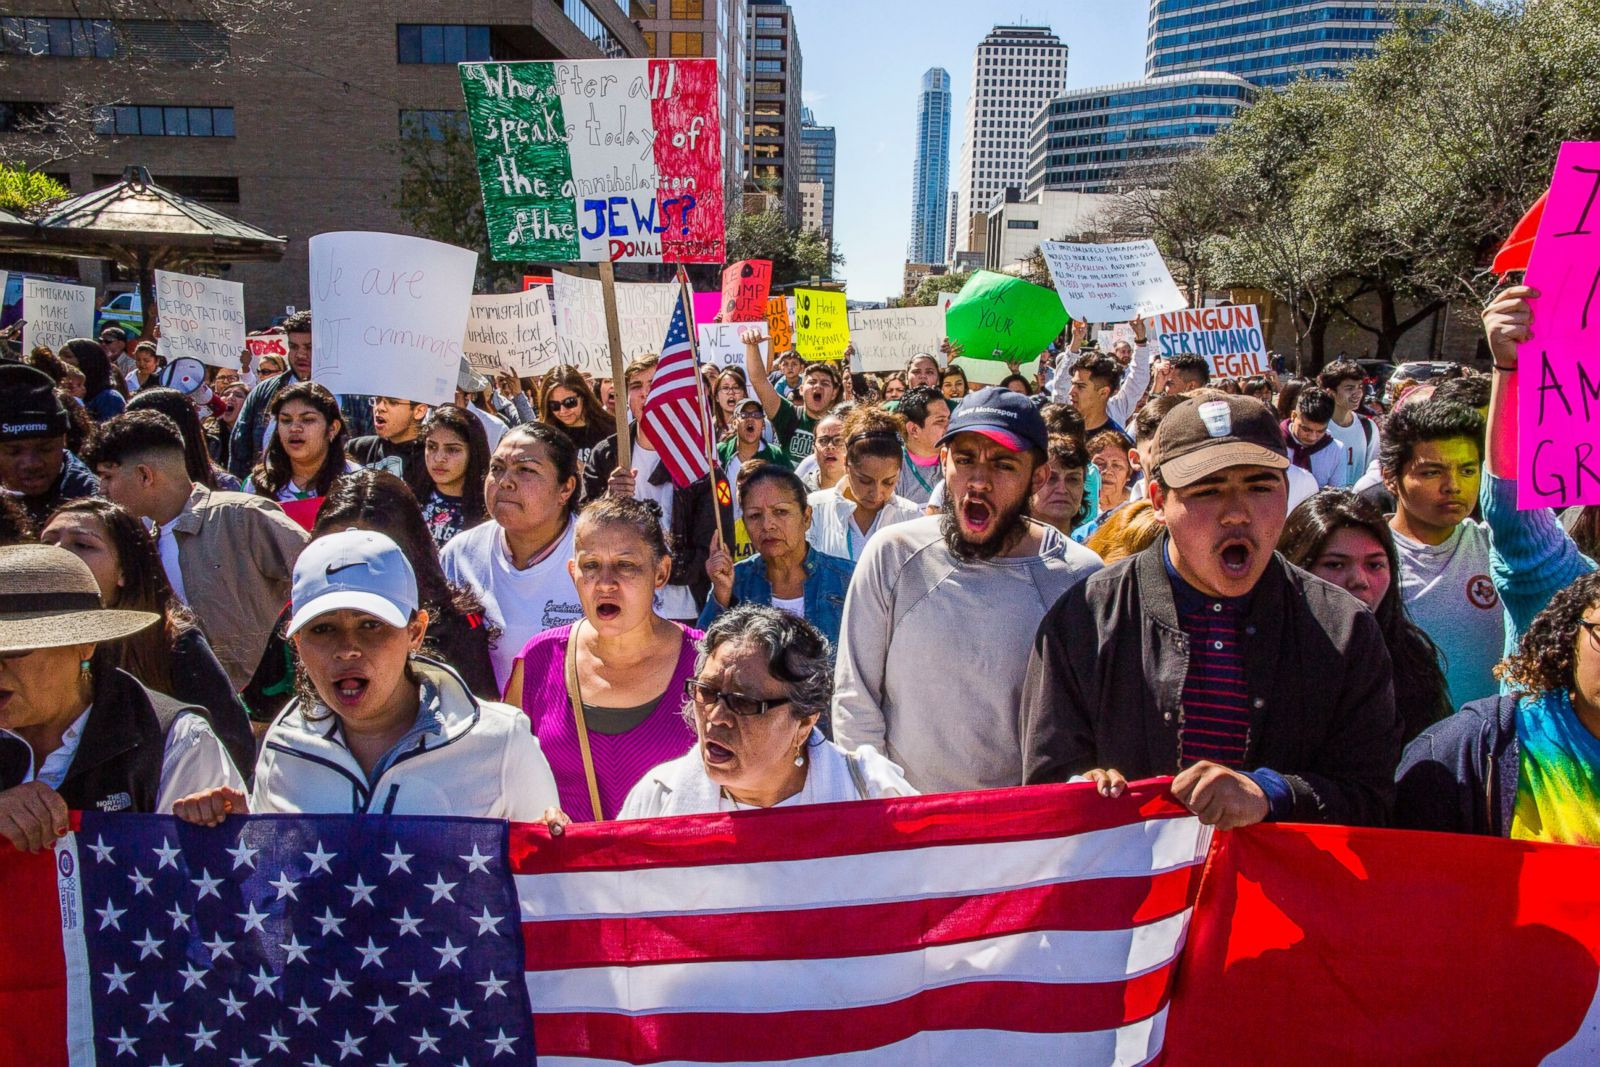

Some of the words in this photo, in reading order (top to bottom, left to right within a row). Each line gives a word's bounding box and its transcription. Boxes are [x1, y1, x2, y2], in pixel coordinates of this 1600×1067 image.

[547, 64, 617, 98] after
[485, 108, 576, 153] speaks
[585, 102, 657, 161] today
[671, 116, 705, 151] of
[495, 154, 548, 196] the
[560, 163, 697, 197] annihilation
[608, 239, 669, 260] DONALD
[26, 282, 85, 302] IMMIGRANTS
[160, 276, 205, 299] STOP
[214, 292, 235, 306] THE
[361, 266, 425, 300] are
[40, 305, 68, 319] MAKE
[159, 298, 244, 325] DEPORTATIONS
[796, 293, 810, 311] NO
[816, 297, 839, 315] Hate
[32, 320, 76, 334] AMERICA
[163, 316, 199, 333] STOP
[208, 326, 232, 341] THE
[516, 320, 541, 343] text
[796, 314, 810, 329] NO
[977, 305, 1016, 337] YOUR
[1160, 307, 1254, 333] NINGUN
[162, 335, 243, 358] SEPARATIONS
[363, 325, 460, 367] criminals
[705, 326, 730, 348] WE
[1159, 332, 1190, 358] SER
[1194, 328, 1262, 356] HUMANO
[516, 336, 558, 367] 72345
[724, 354, 744, 364] OUR
[975, 406, 1018, 419] Motorsport
[2, 423, 48, 435] Supreme
[106, 793, 121, 801] THE
